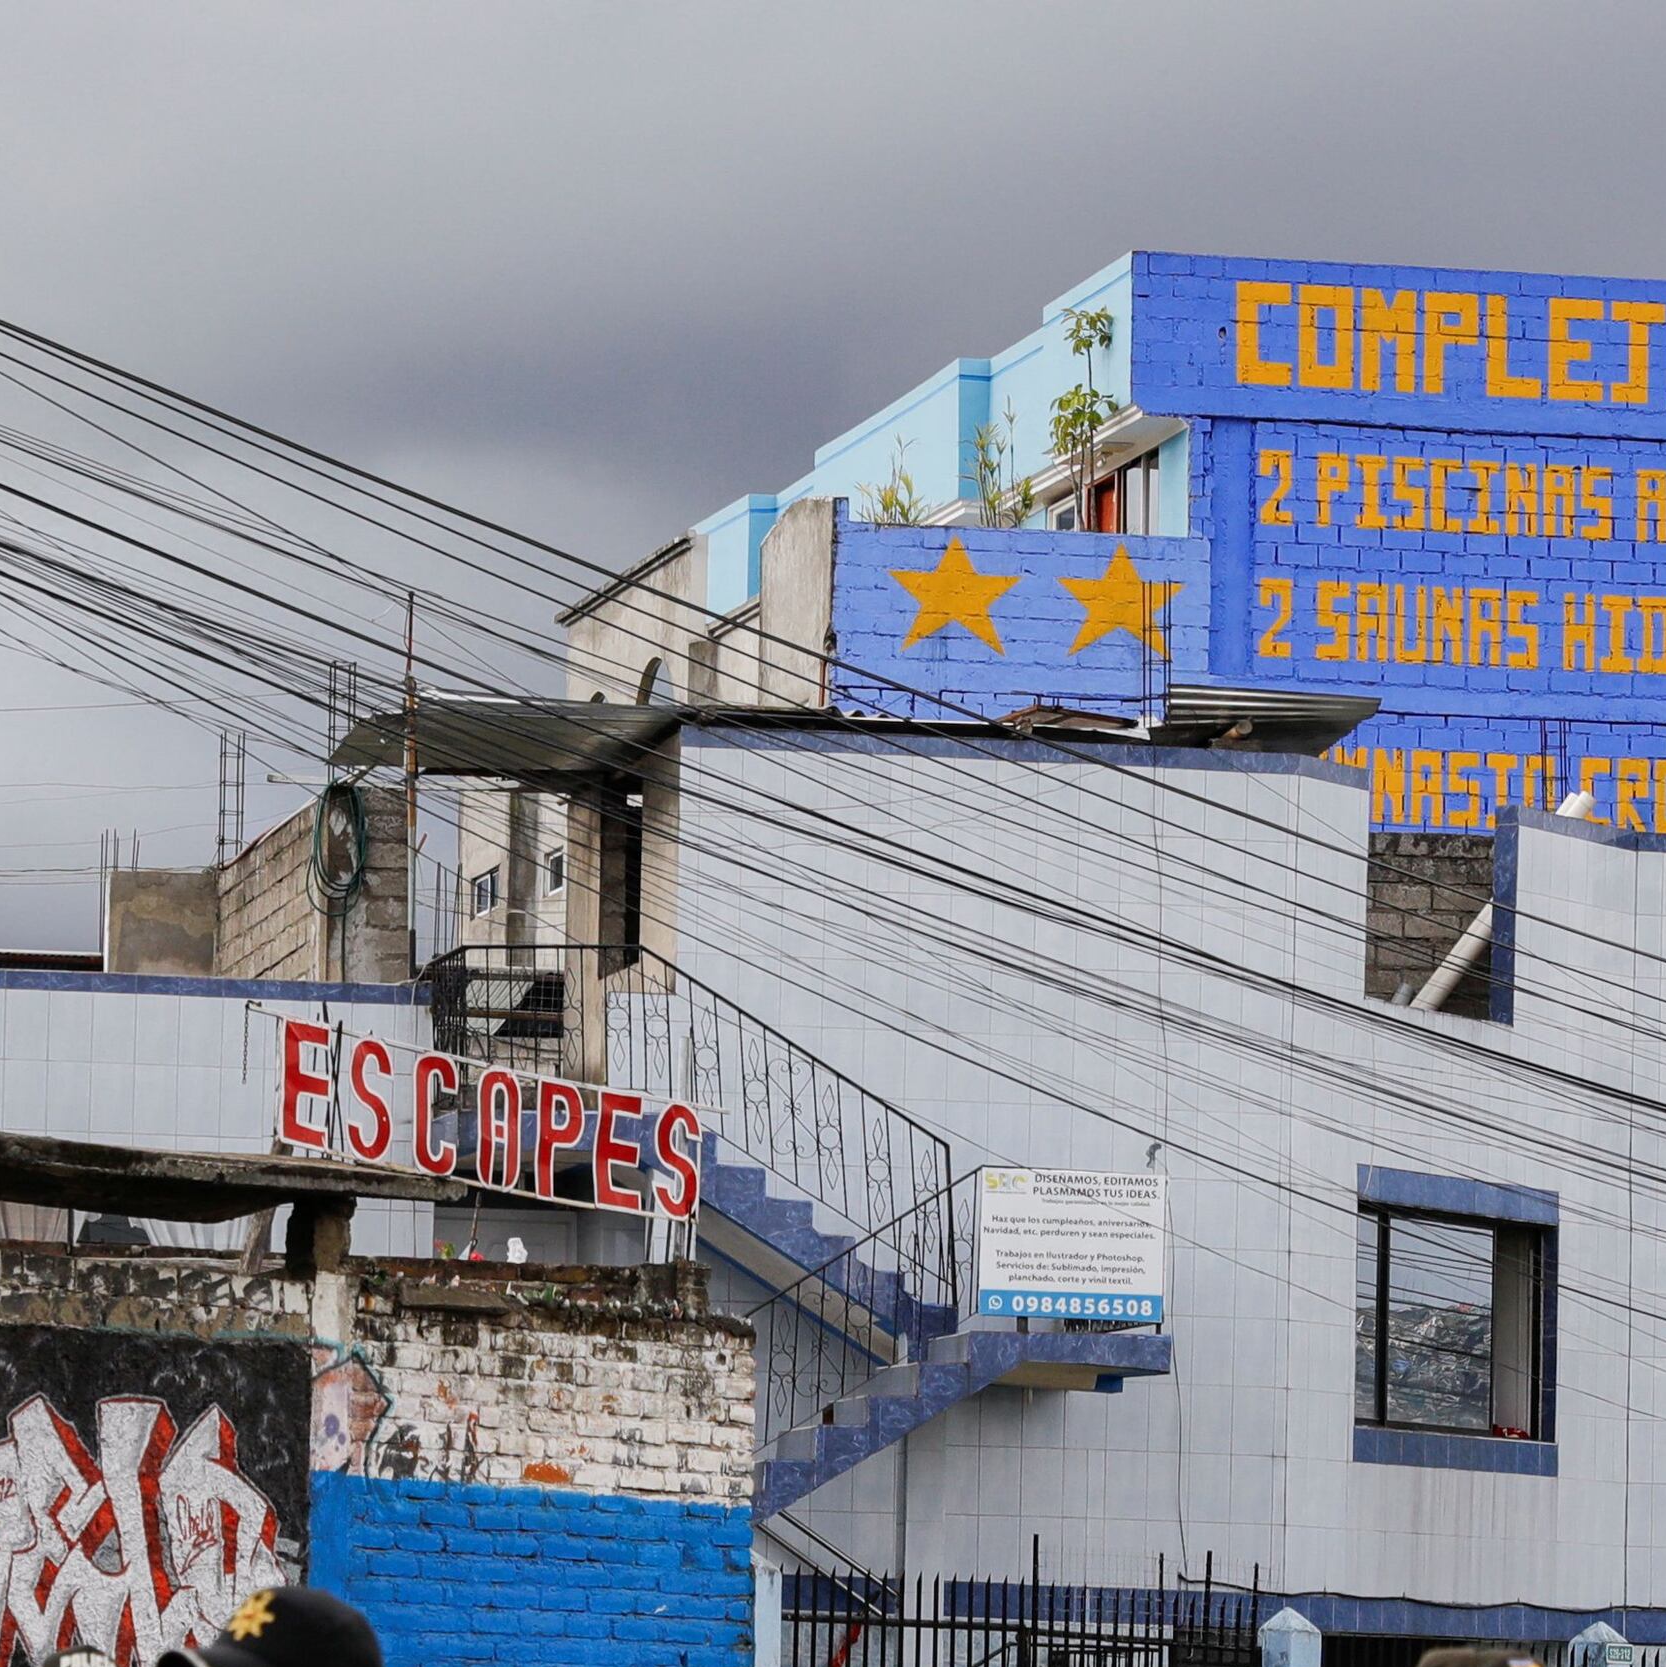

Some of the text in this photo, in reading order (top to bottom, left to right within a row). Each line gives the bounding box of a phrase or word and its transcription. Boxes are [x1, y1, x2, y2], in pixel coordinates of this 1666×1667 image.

[1257, 449, 1294, 526] 2
[1314, 452, 1615, 541] PISCINAS
[1257, 577, 1294, 658] 2
[1314, 580, 1540, 670] SAUNAS
[279, 1017, 704, 1222] ESCAPES
[1034, 1173, 1159, 1187] DISEÑAMOS, EDITAMOS
[1033, 1186, 1101, 1198] PLASMAMOS
[1103, 1189, 1124, 1199] TUS
[1028, 1216, 1040, 1224] los
[1040, 1229, 1080, 1237] perduren
[996, 1250, 1032, 1259] Trabajos
[996, 1261, 1034, 1270] Servicios
[1057, 1275, 1080, 1283] corte
[1011, 1295, 1153, 1316] 0984856508
